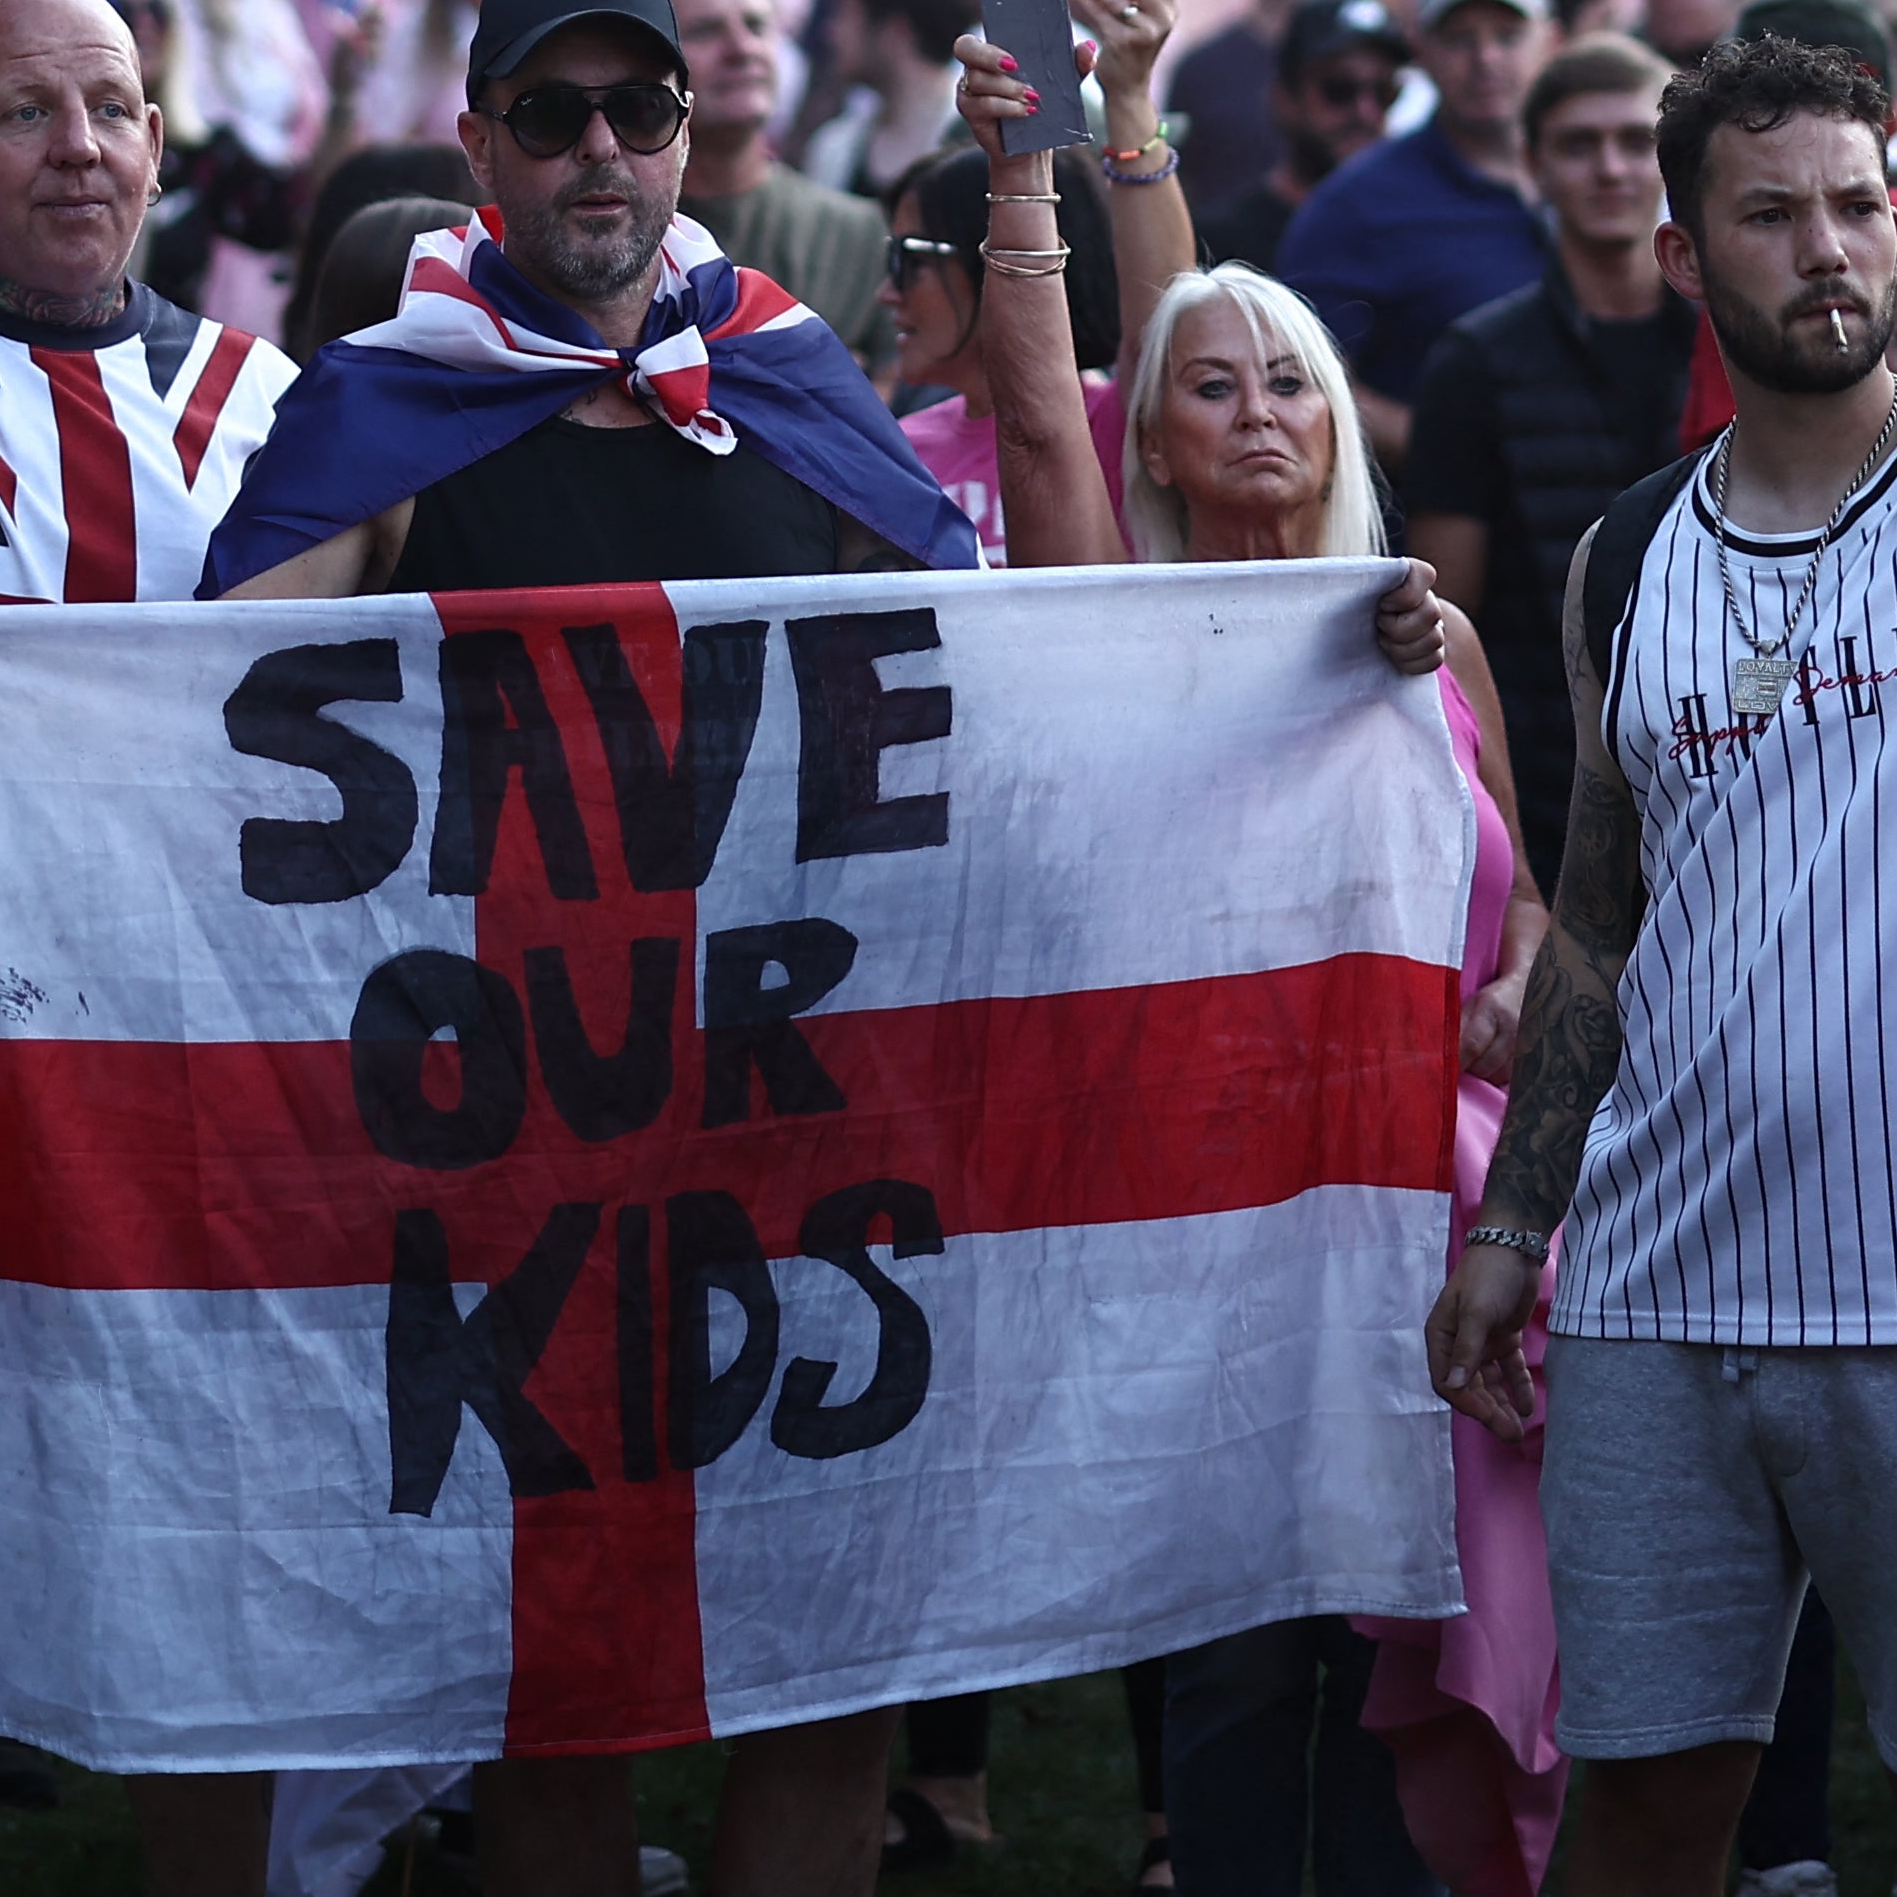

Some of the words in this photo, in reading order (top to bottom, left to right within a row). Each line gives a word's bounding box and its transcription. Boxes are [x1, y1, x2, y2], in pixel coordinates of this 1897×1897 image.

[222, 607, 952, 906] SAVE
[1738, 700, 1779, 711] LOV
[348, 915, 859, 1170] OUR
[388, 1178, 946, 1517] KIDS
